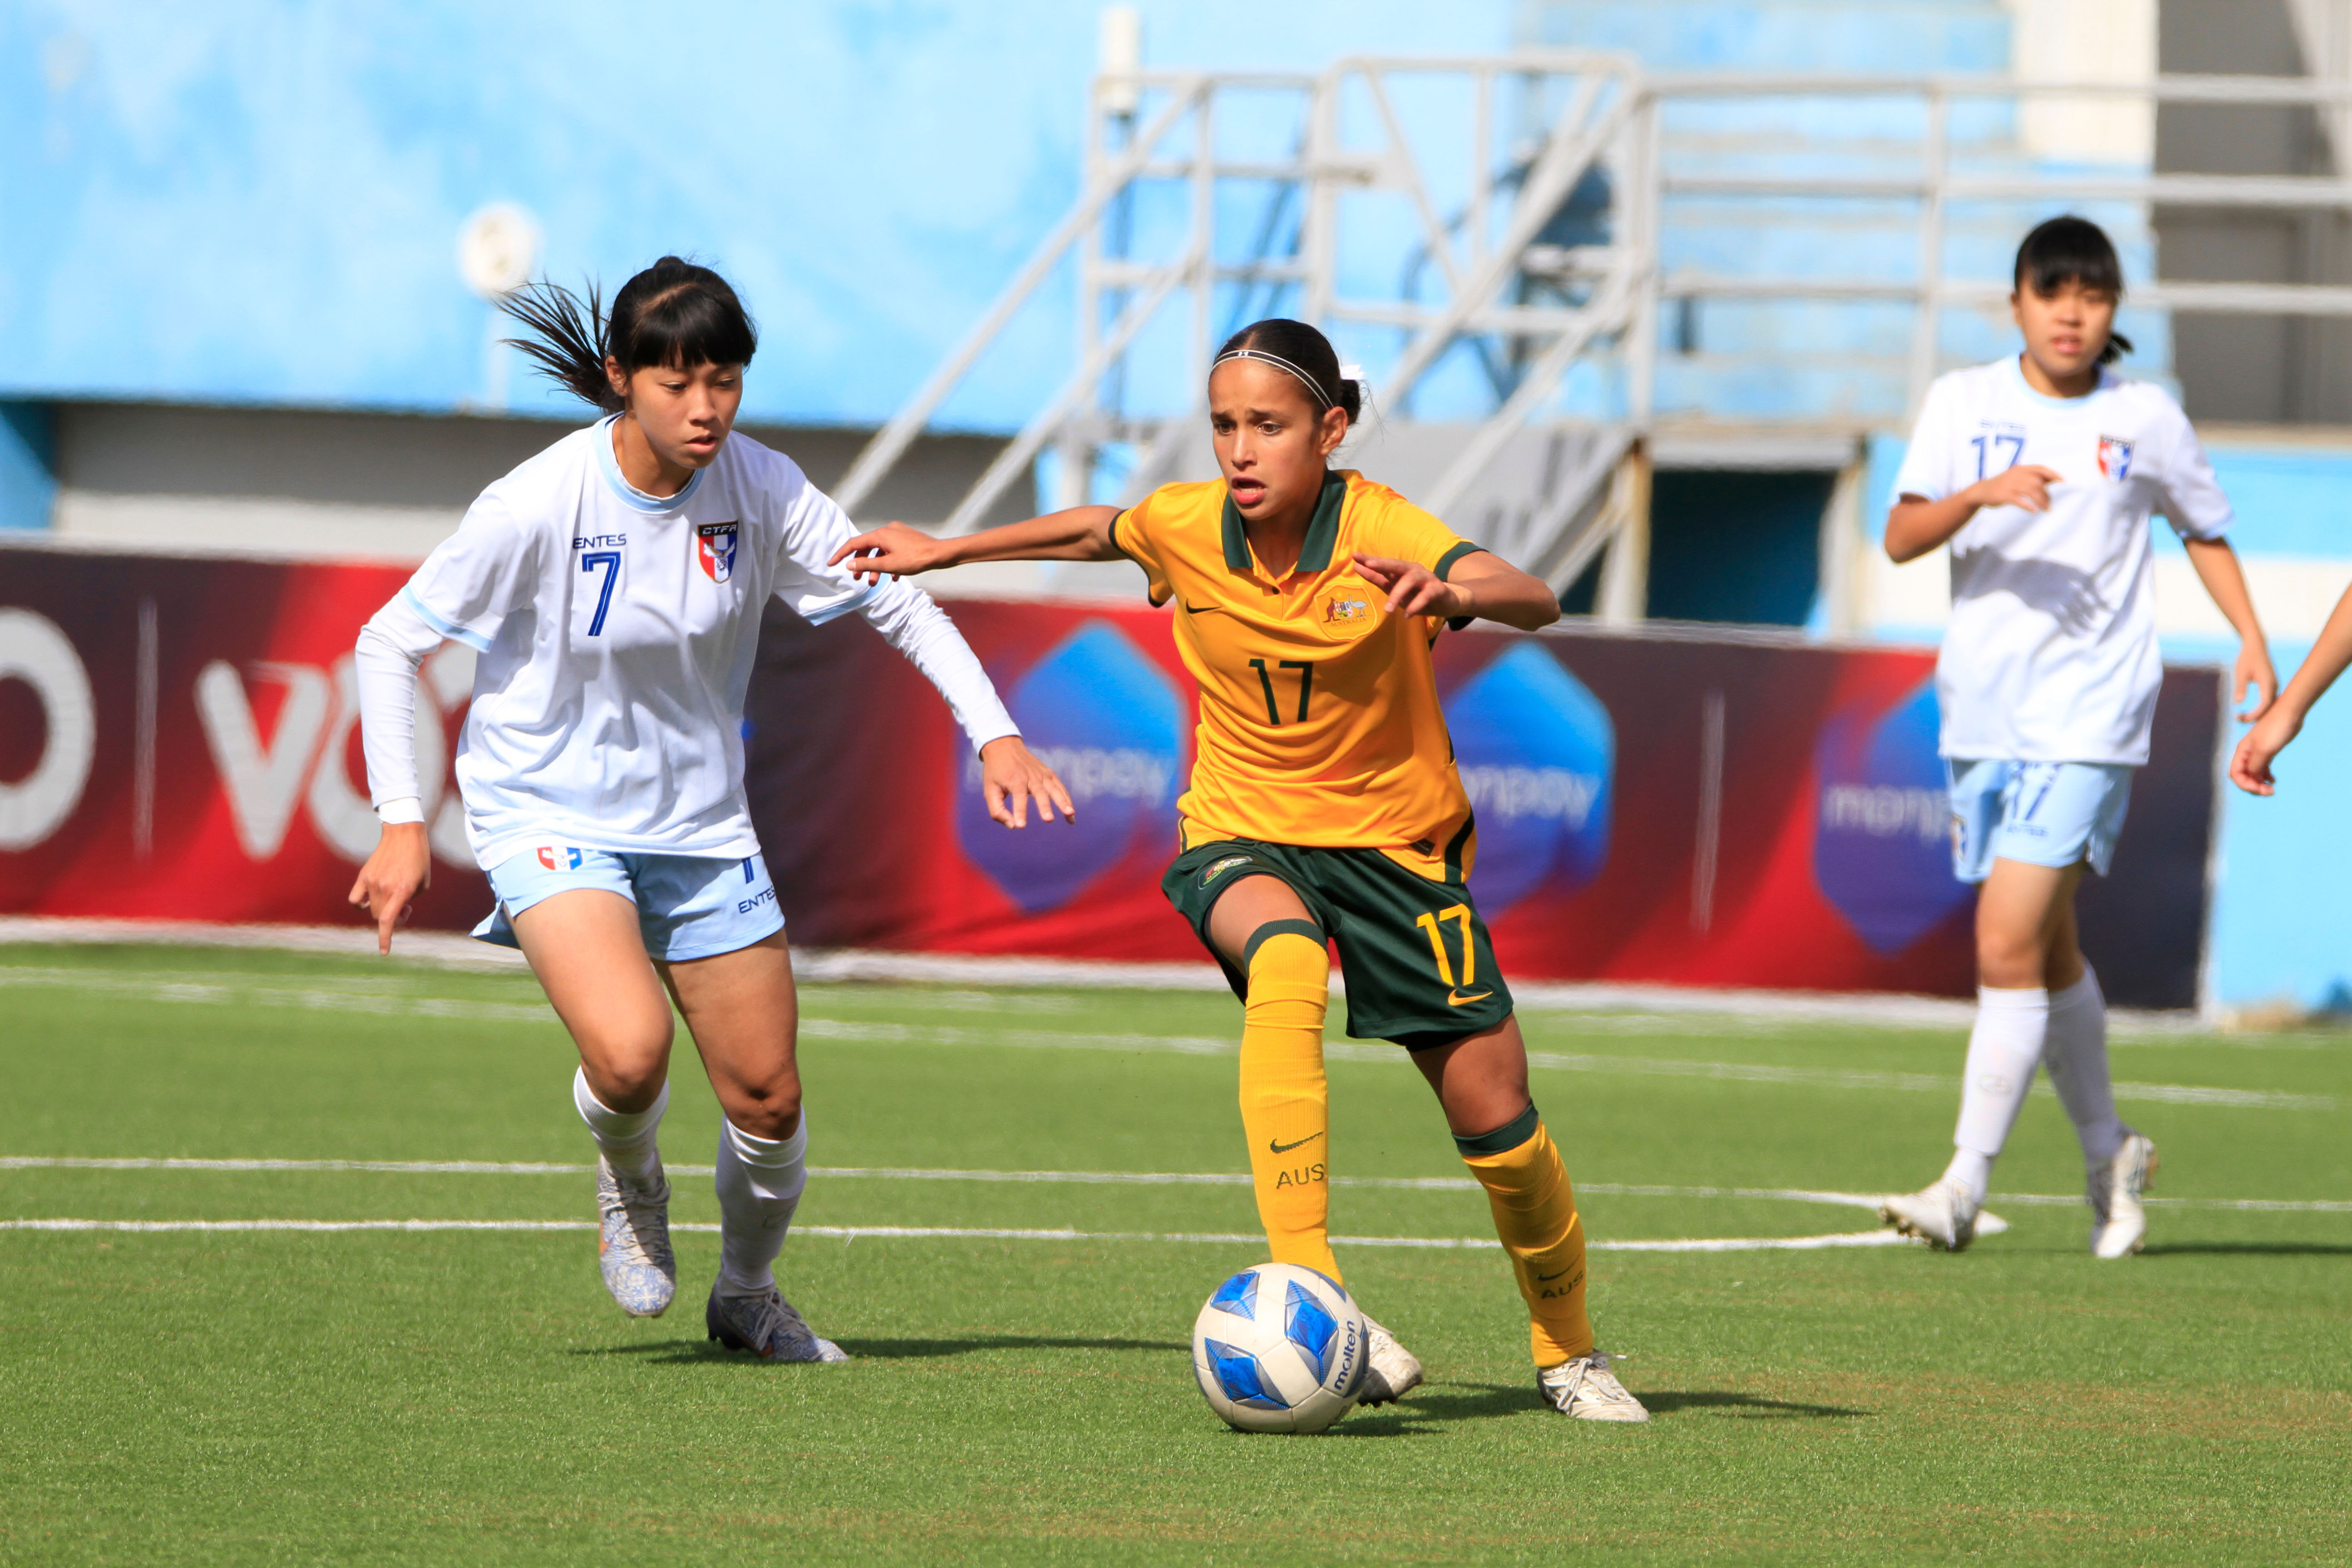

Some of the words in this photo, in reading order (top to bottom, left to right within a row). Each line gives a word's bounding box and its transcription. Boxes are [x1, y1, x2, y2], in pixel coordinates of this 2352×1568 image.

[1972, 435, 2024, 481] 17
[573, 533, 627, 549] ENTES
[703, 524, 737, 534] CTFA
[582, 552, 621, 636] 7
[1331, 617, 1367, 627] AUSTRALIA
[1249, 659, 1313, 725] 17
[1417, 903, 1474, 986] 17
[1276, 1163, 1324, 1189] AUS
[1541, 1270, 1583, 1299] AUS
[1334, 1320, 1356, 1390] molten
